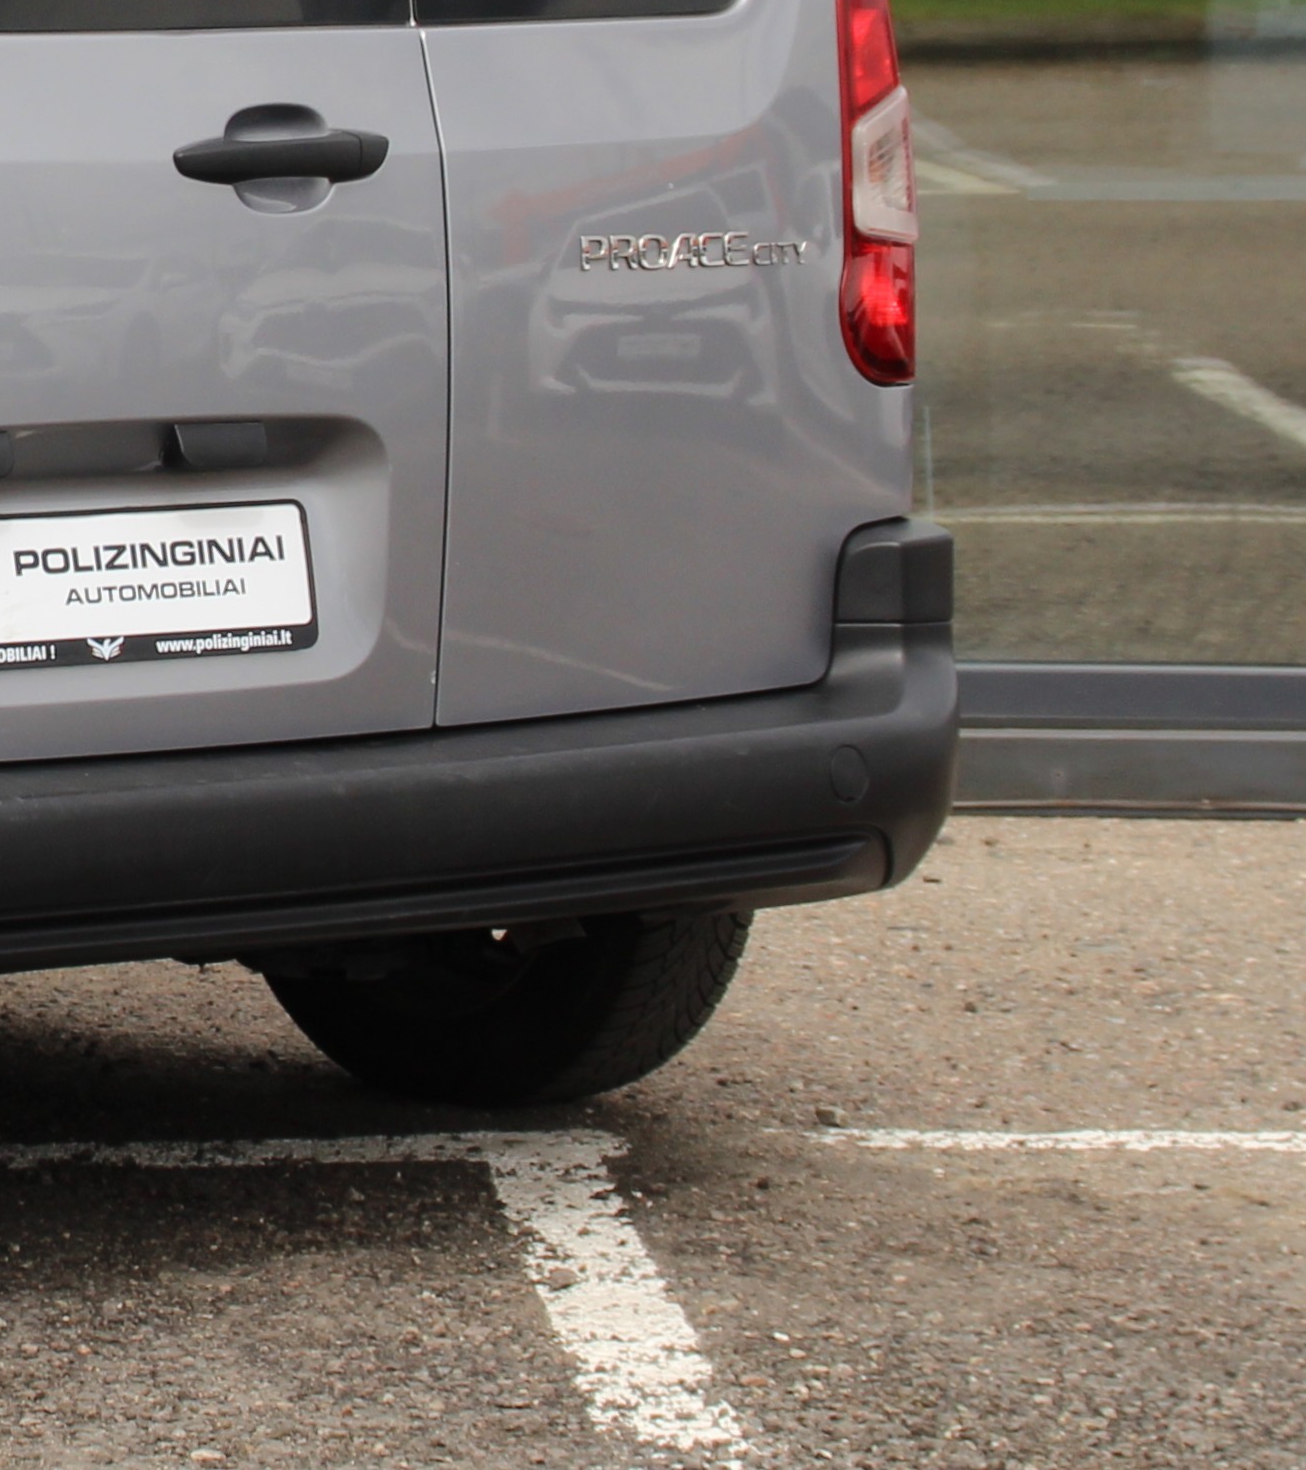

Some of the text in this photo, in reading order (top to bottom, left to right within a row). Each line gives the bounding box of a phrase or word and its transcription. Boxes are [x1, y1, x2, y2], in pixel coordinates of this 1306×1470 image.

[580, 231, 807, 271] PROACE CITY
[13, 535, 286, 576] POLIZINGINIAI
[65, 578, 247, 605] AUTOMOBILIAI
[155, 629, 293, 655] www.polizinginiai.lt
